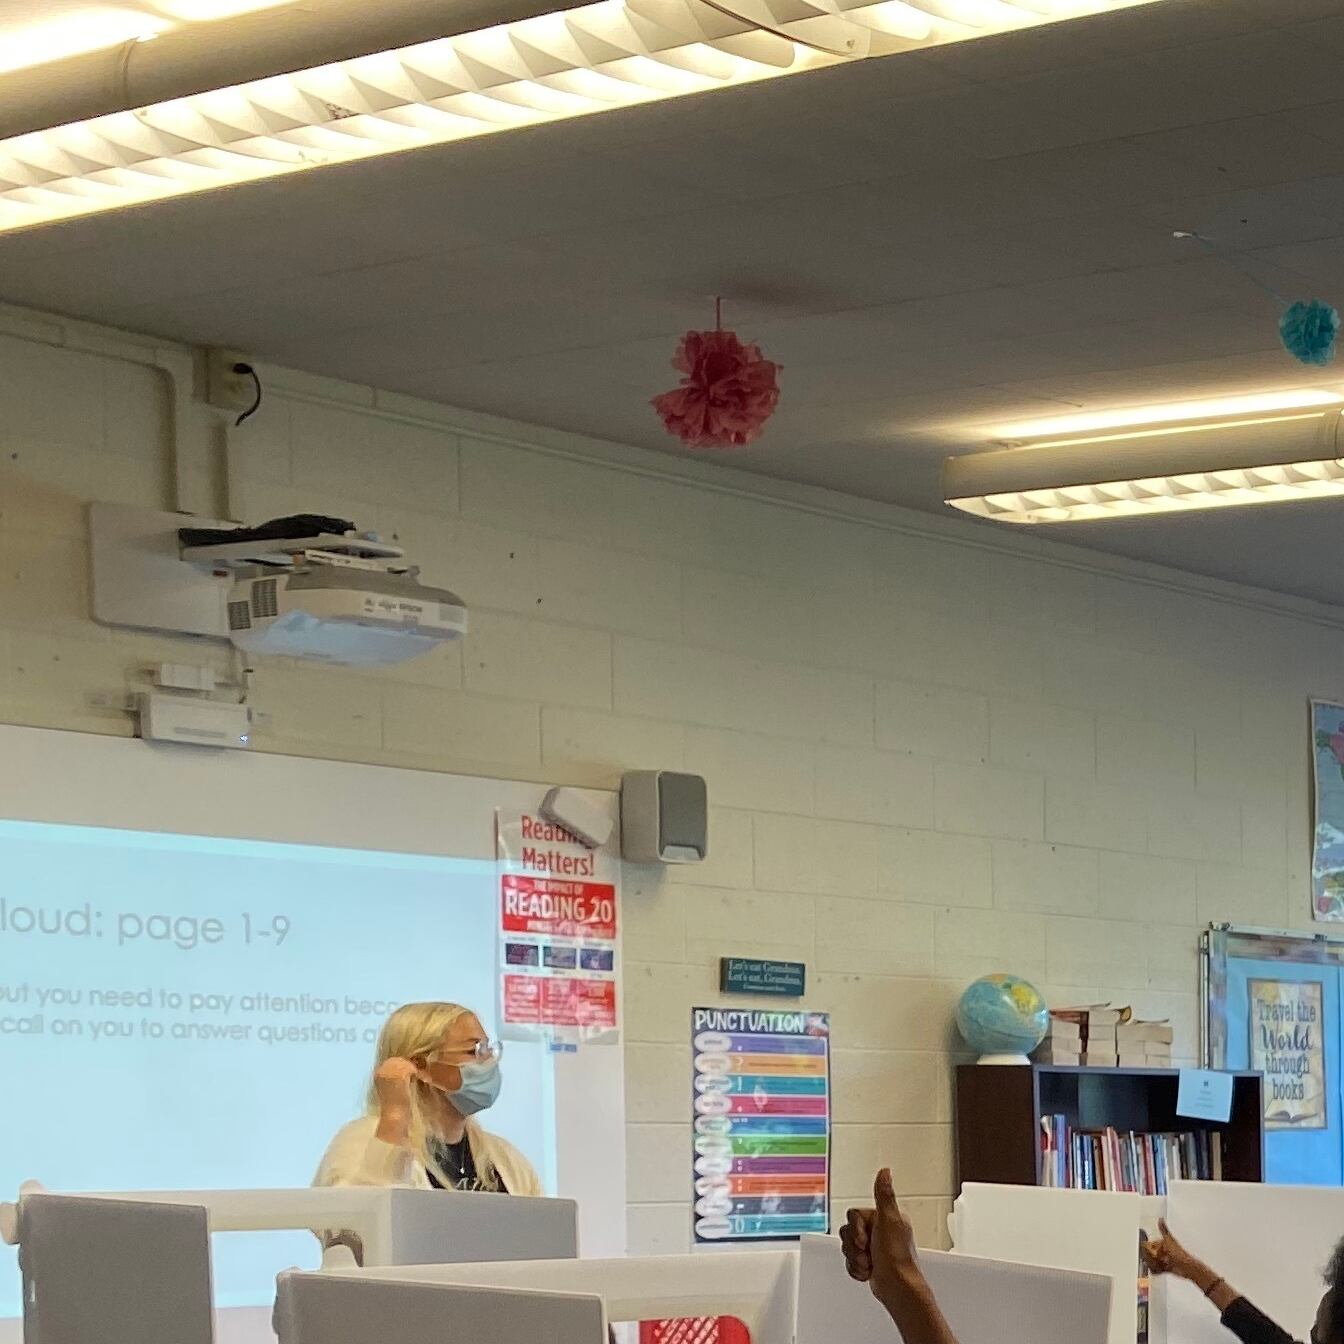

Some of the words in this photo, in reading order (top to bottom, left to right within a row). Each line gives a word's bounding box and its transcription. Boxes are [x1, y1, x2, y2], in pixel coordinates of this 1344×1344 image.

[522, 847, 595, 876] Matters!
[505, 888, 585, 920] READING
[590, 896, 613, 923] 20
[0, 897, 103, 938] loud:
[117, 911, 225, 949] page
[241, 912, 291, 946] 1-9
[36, 987, 82, 1011] you
[89, 986, 153, 1008] need
[159, 989, 182, 1009] to
[190, 992, 234, 1014] pay
[240, 990, 338, 1015] attention
[1255, 998, 1294, 1022] Travel
[1296, 999, 1317, 1021] the
[1, 1013, 44, 1034] call
[51, 1017, 82, 1036] on
[89, 1019, 134, 1042] you
[140, 1018, 164, 1037] to
[171, 1023, 252, 1041] answer
[258, 1022, 357, 1045] questions
[694, 1010, 805, 1033] PUNCTUATION
[1262, 1026, 1314, 1052] World
[1264, 1052, 1312, 1075] through
[1271, 1078, 1305, 1101] books
